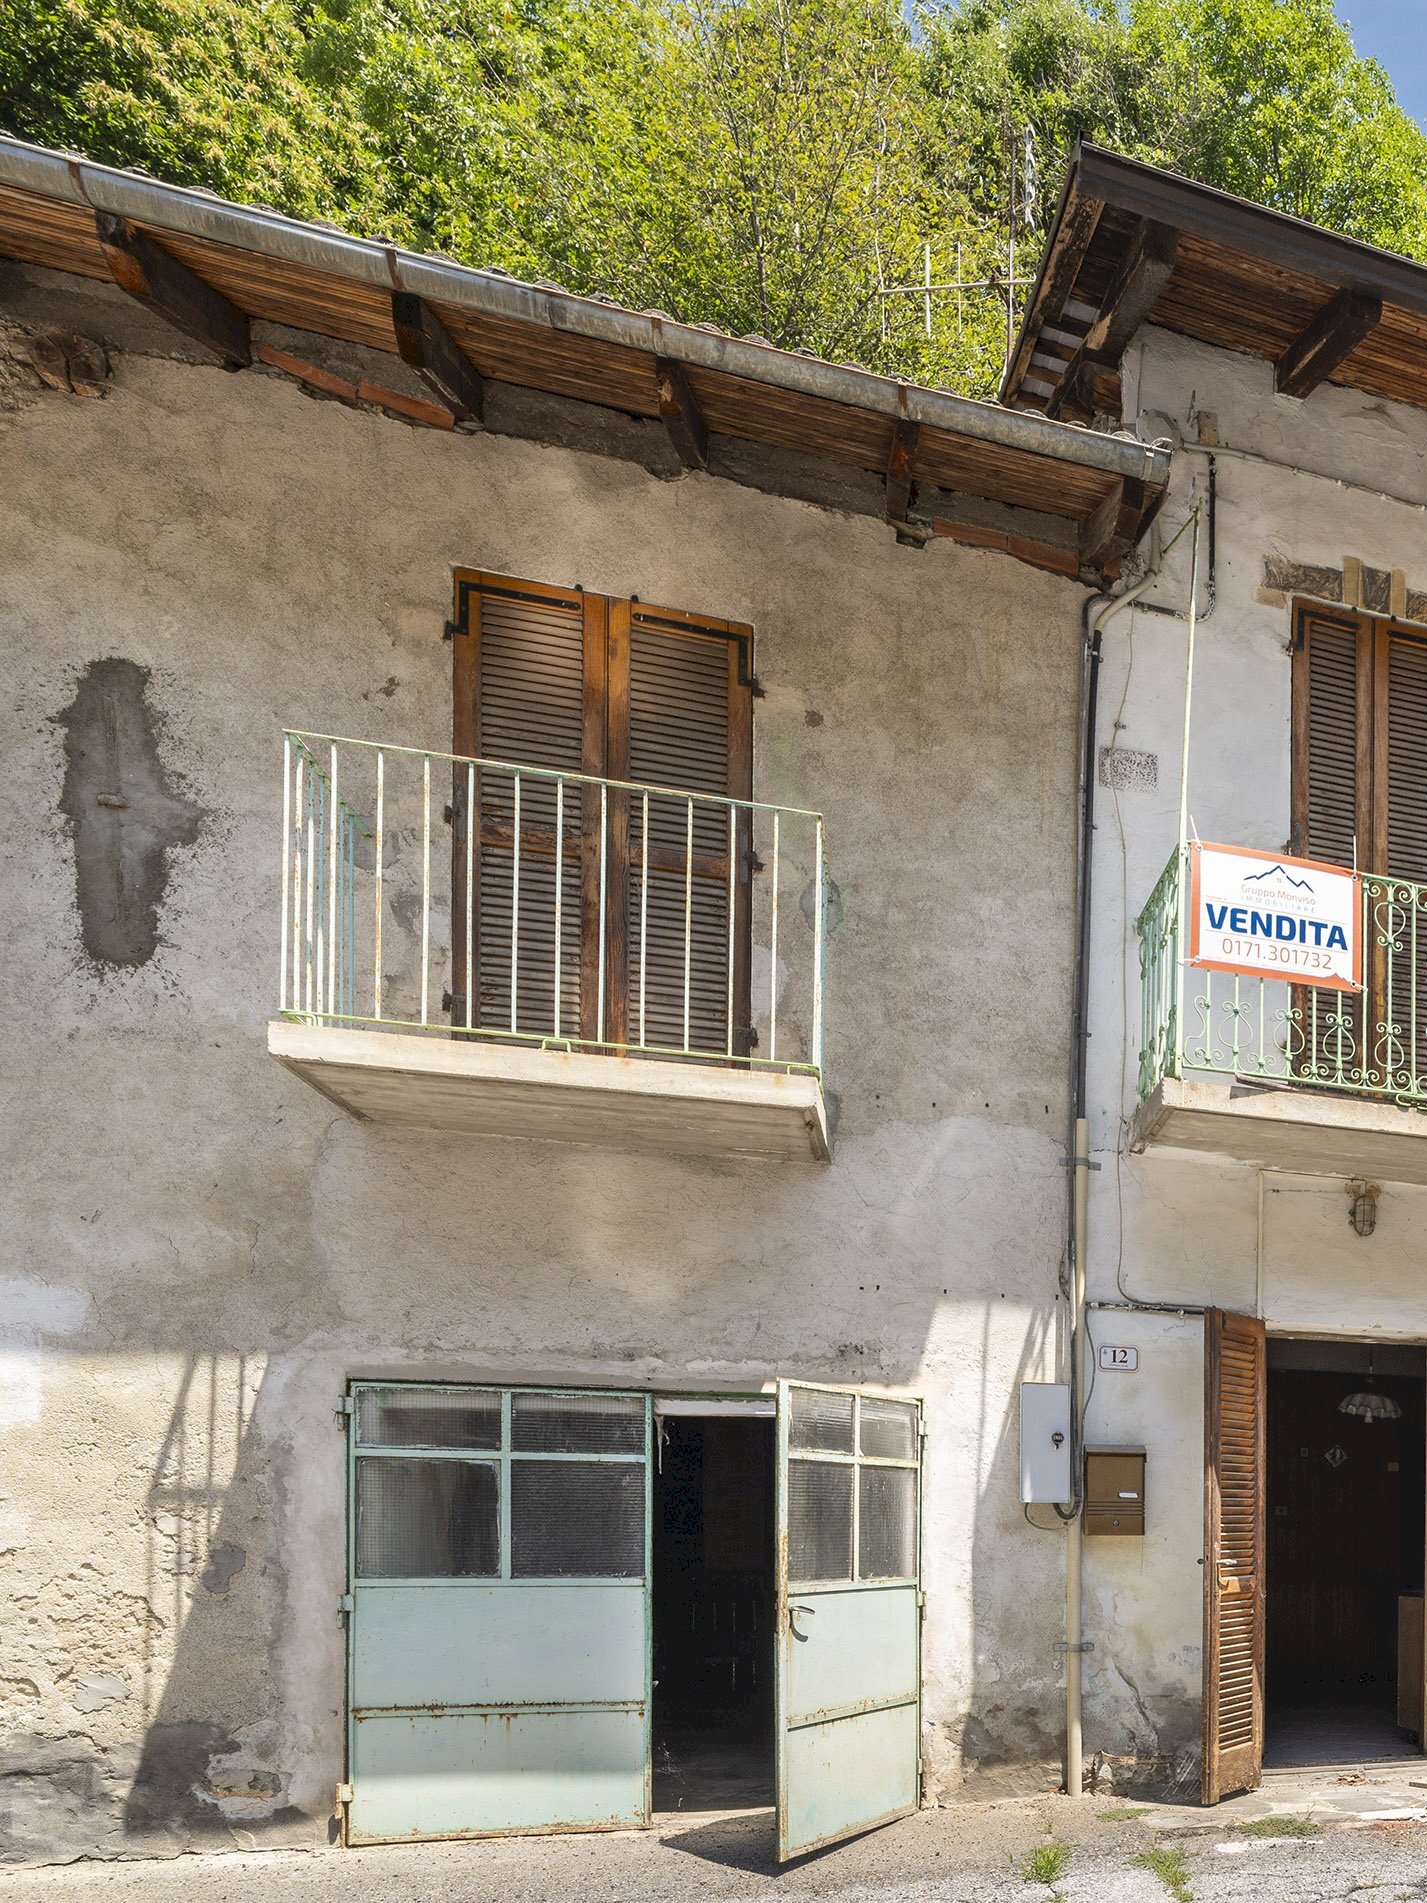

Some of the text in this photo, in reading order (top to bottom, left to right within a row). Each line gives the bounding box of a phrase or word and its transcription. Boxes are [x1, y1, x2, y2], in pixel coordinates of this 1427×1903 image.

[1241, 884, 1275, 898] Gruppo
[1277, 890, 1316, 905] Monviso
[1205, 903, 1348, 951] VENDITA
[1222, 938, 1332, 970] 0171.301732
[1111, 1349, 1128, 1363] 12
